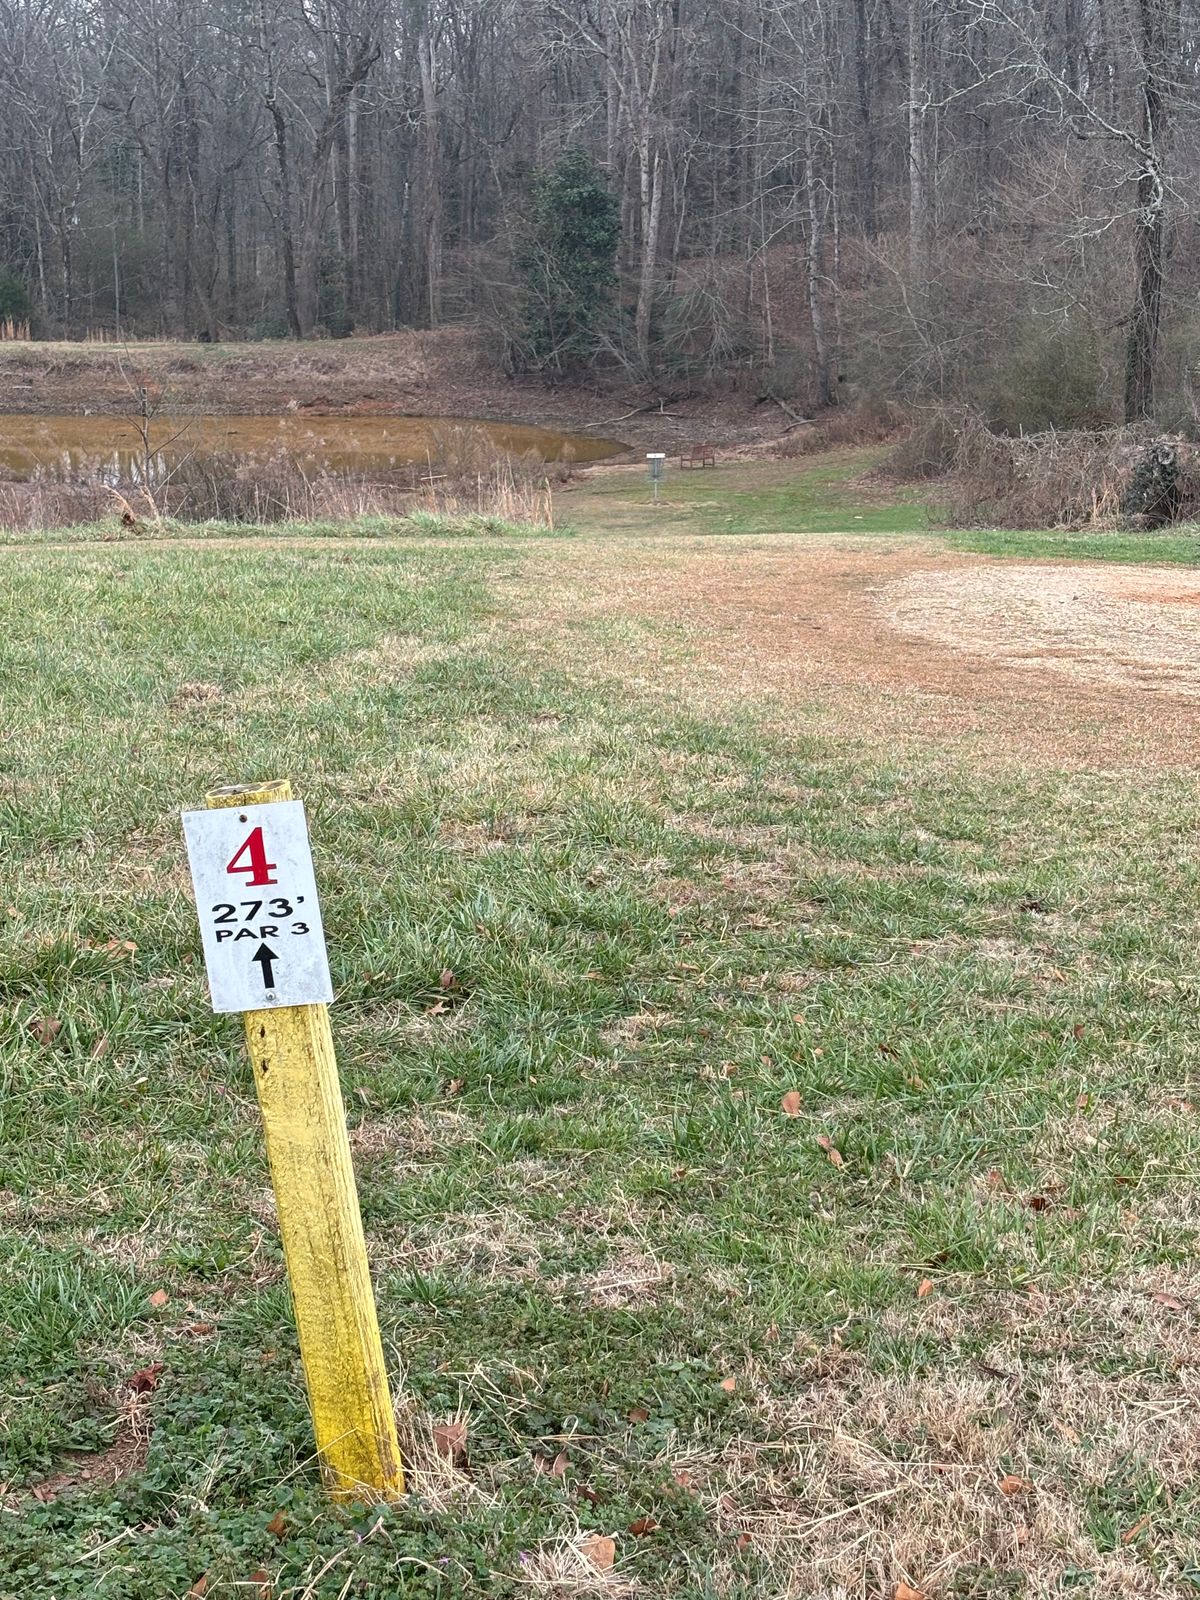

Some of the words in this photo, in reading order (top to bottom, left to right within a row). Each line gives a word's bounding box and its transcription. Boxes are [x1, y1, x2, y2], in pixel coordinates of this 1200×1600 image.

[226, 826, 278, 887] 4
[211, 896, 305, 924] 273'
[215, 925, 280, 943] PAR
[290, 922, 310, 935] 3
